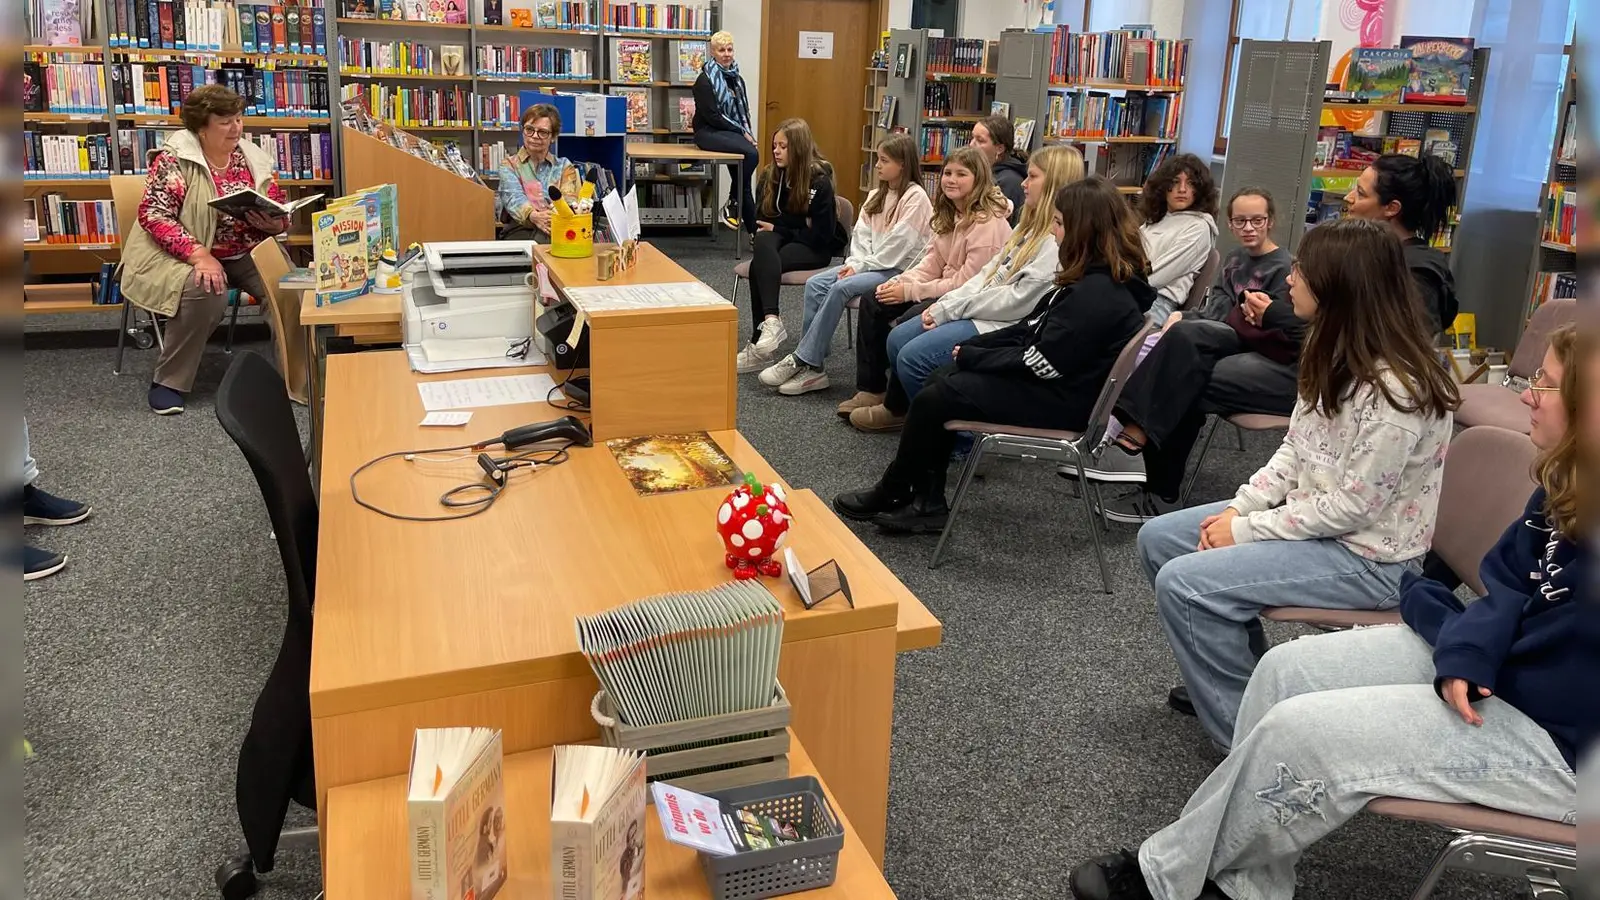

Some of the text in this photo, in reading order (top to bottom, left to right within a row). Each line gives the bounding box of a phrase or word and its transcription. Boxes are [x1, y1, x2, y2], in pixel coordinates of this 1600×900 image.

[1362, 50, 1409, 58] CASCADIA
[332, 219, 365, 236] MISSION
[448, 799, 470, 842] LITTLE
[472, 760, 503, 811] GERMANY
[417, 825, 432, 881] LITTLE GERMANY
[595, 821, 616, 864] LITTLE
[562, 845, 577, 879] GERMANY
